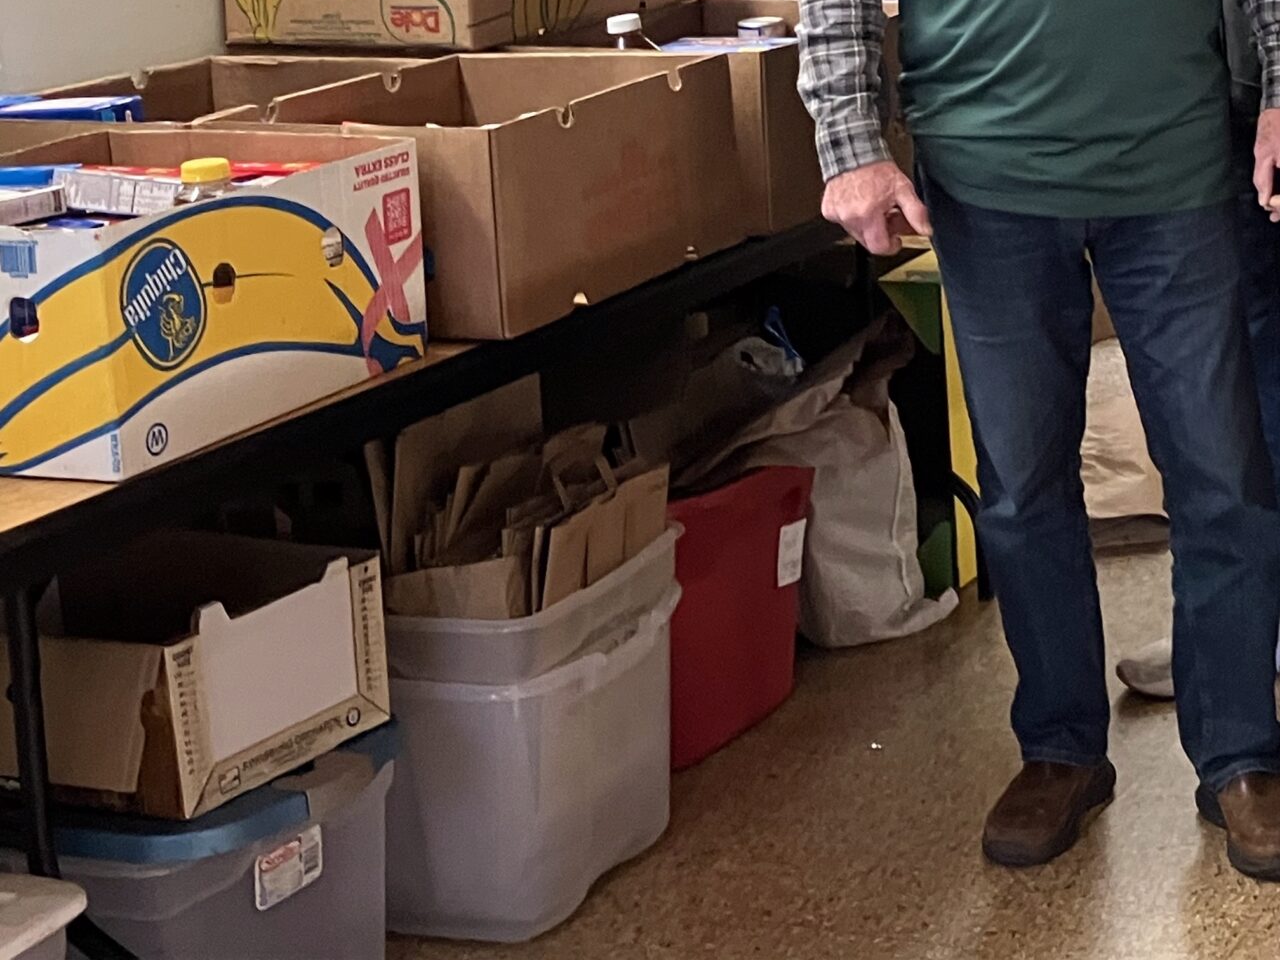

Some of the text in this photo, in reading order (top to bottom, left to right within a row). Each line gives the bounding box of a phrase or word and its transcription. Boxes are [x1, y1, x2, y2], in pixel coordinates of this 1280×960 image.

[390, 8, 440, 33] Dole
[354, 151, 410, 178] CLASS EXTRA
[124, 248, 188, 327] Chiquita
